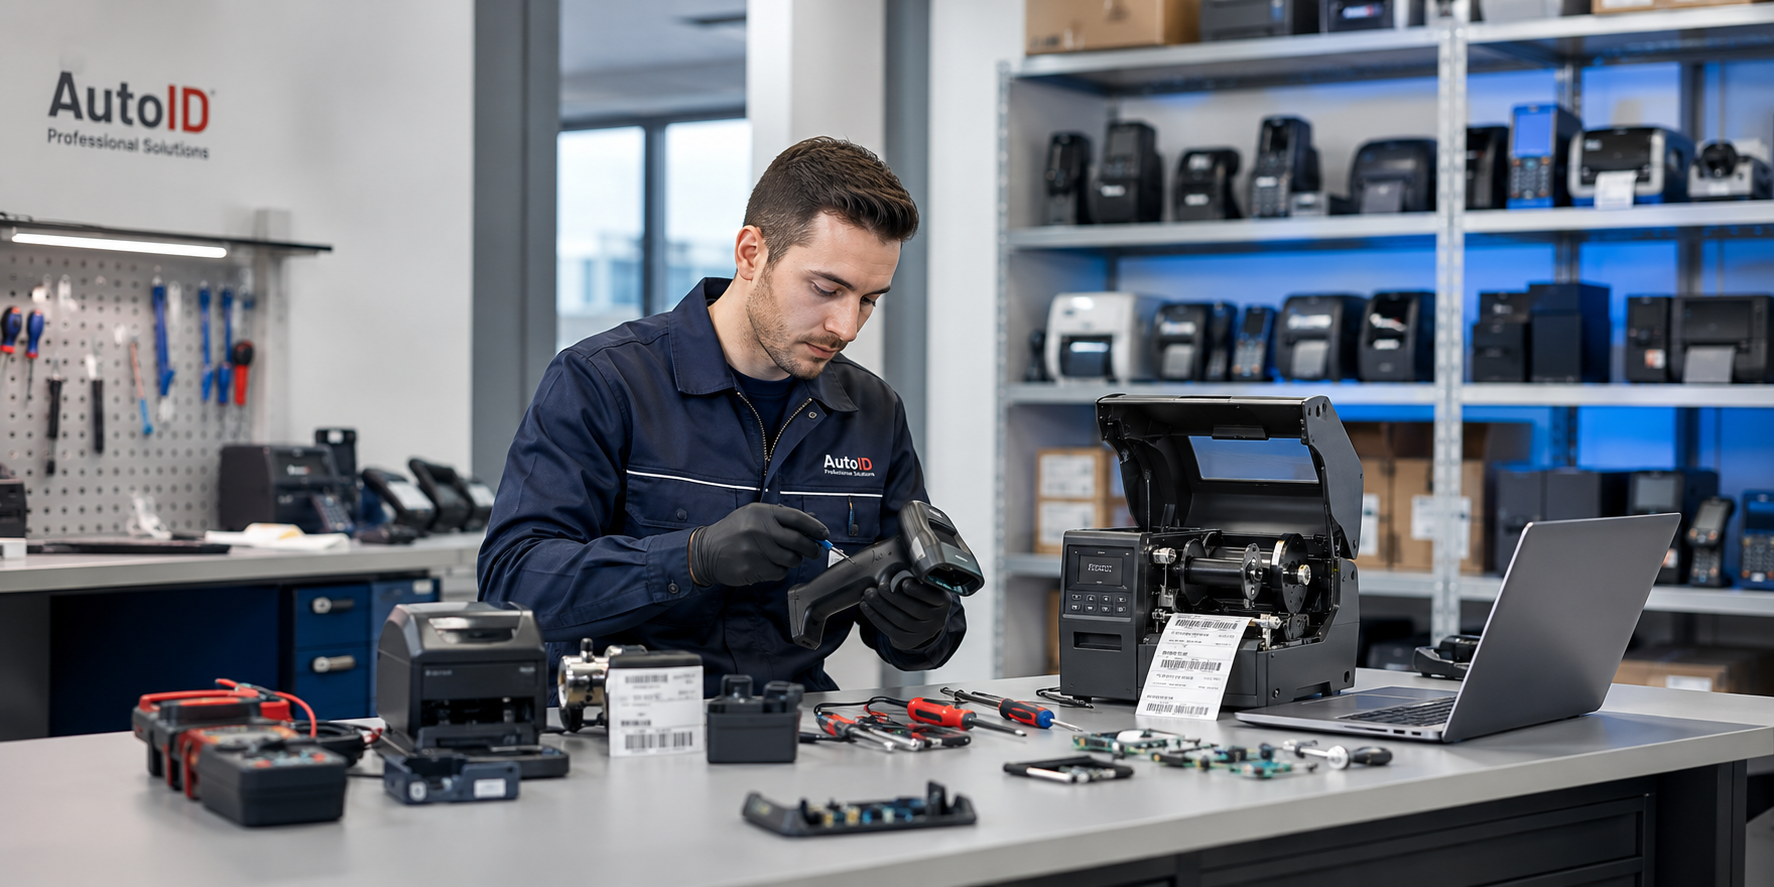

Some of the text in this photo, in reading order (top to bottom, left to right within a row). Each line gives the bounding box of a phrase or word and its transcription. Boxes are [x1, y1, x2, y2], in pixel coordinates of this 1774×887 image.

[48, 70, 210, 134] AutoID
[47, 128, 210, 160] Professional Solutions
[824, 454, 873, 471] AutoID
